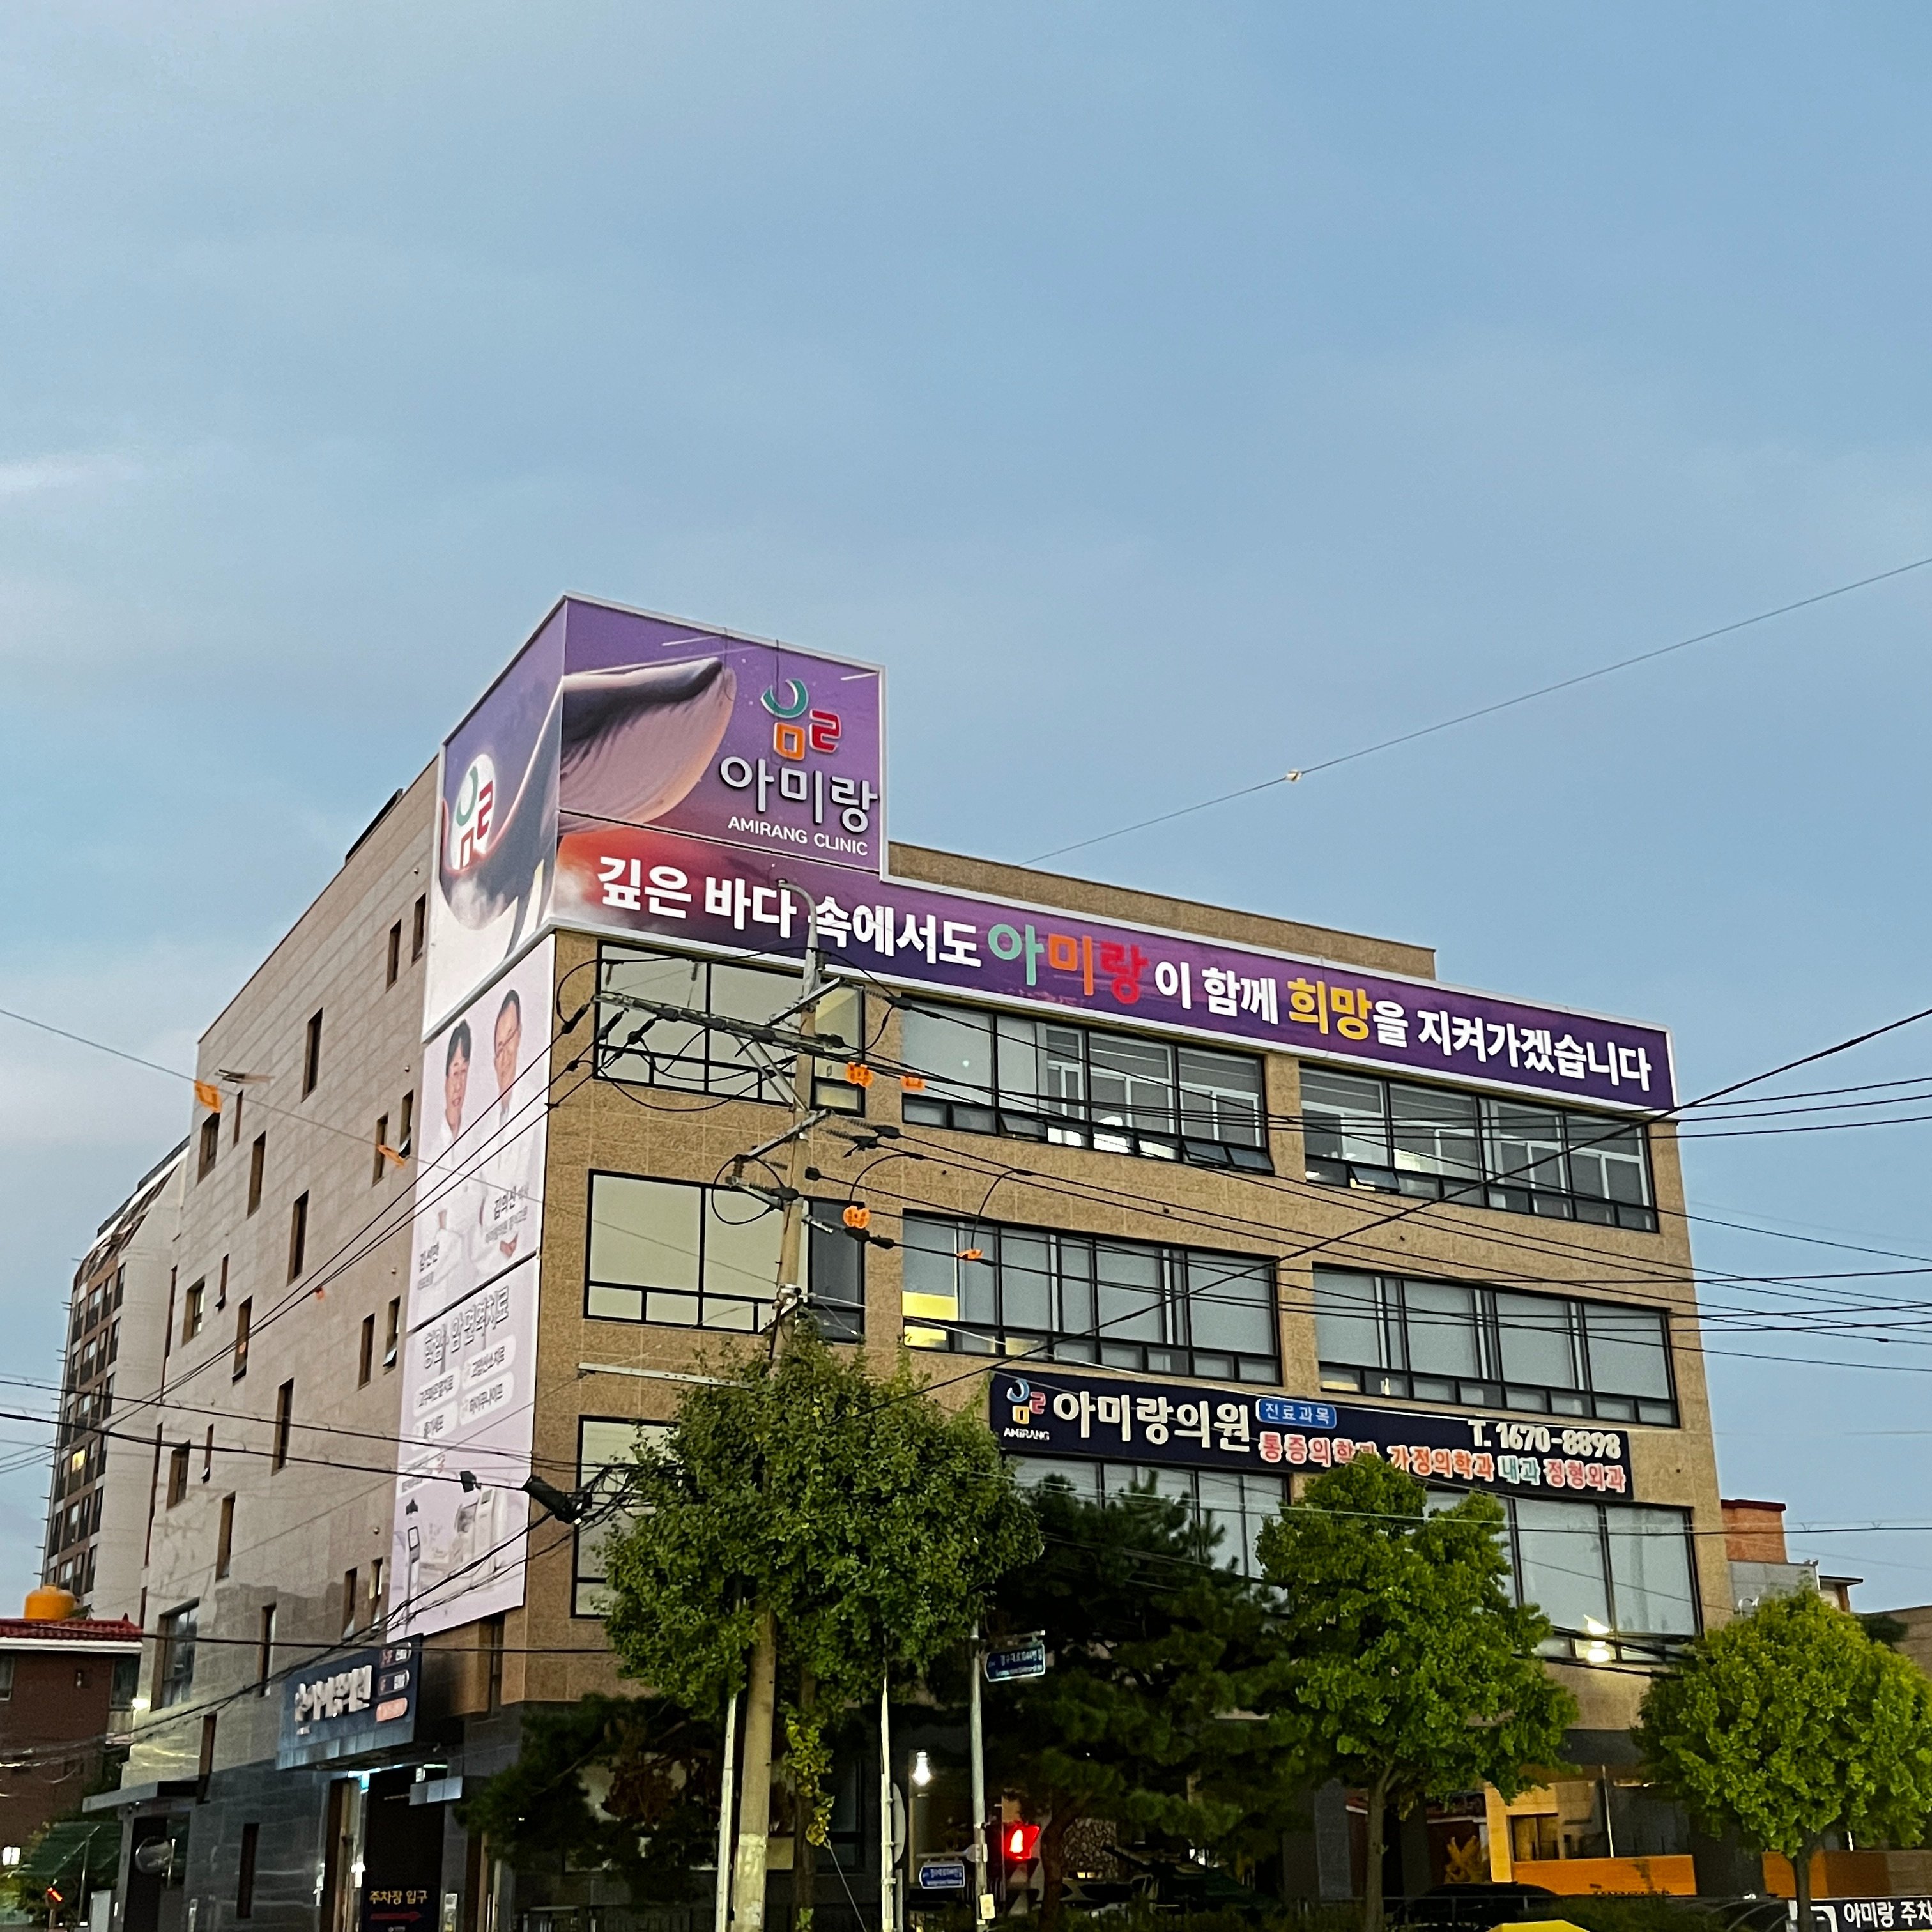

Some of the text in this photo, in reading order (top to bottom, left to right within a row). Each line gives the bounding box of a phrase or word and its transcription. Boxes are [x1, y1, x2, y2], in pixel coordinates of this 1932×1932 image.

[720, 756, 878, 833] 아미랑
[728, 816, 868, 857] AMIRANG CLINIC
[597, 856, 692, 919] 깊은
[705, 877, 797, 939] 바다
[808, 896, 982, 968] 속에서도
[1202, 966, 1278, 1024] 함께
[1287, 977, 1409, 1047] 희망을
[1417, 1009, 1652, 1091] 지켜가겠습니다
[1053, 1390, 1251, 1452] 아미랑의원
[1265, 1402, 1330, 1425] 진료과목
[1496, 1422, 1621, 1460] 1670-8898
[1388, 1445, 1494, 1482] 가정의학과
[1497, 1455, 1541, 1485] 내과
[1543, 1459, 1626, 1494] 정형외과
[369, 1890, 428, 1905] 주차장 입구
[1843, 1901, 1895, 1928] 아미랑
